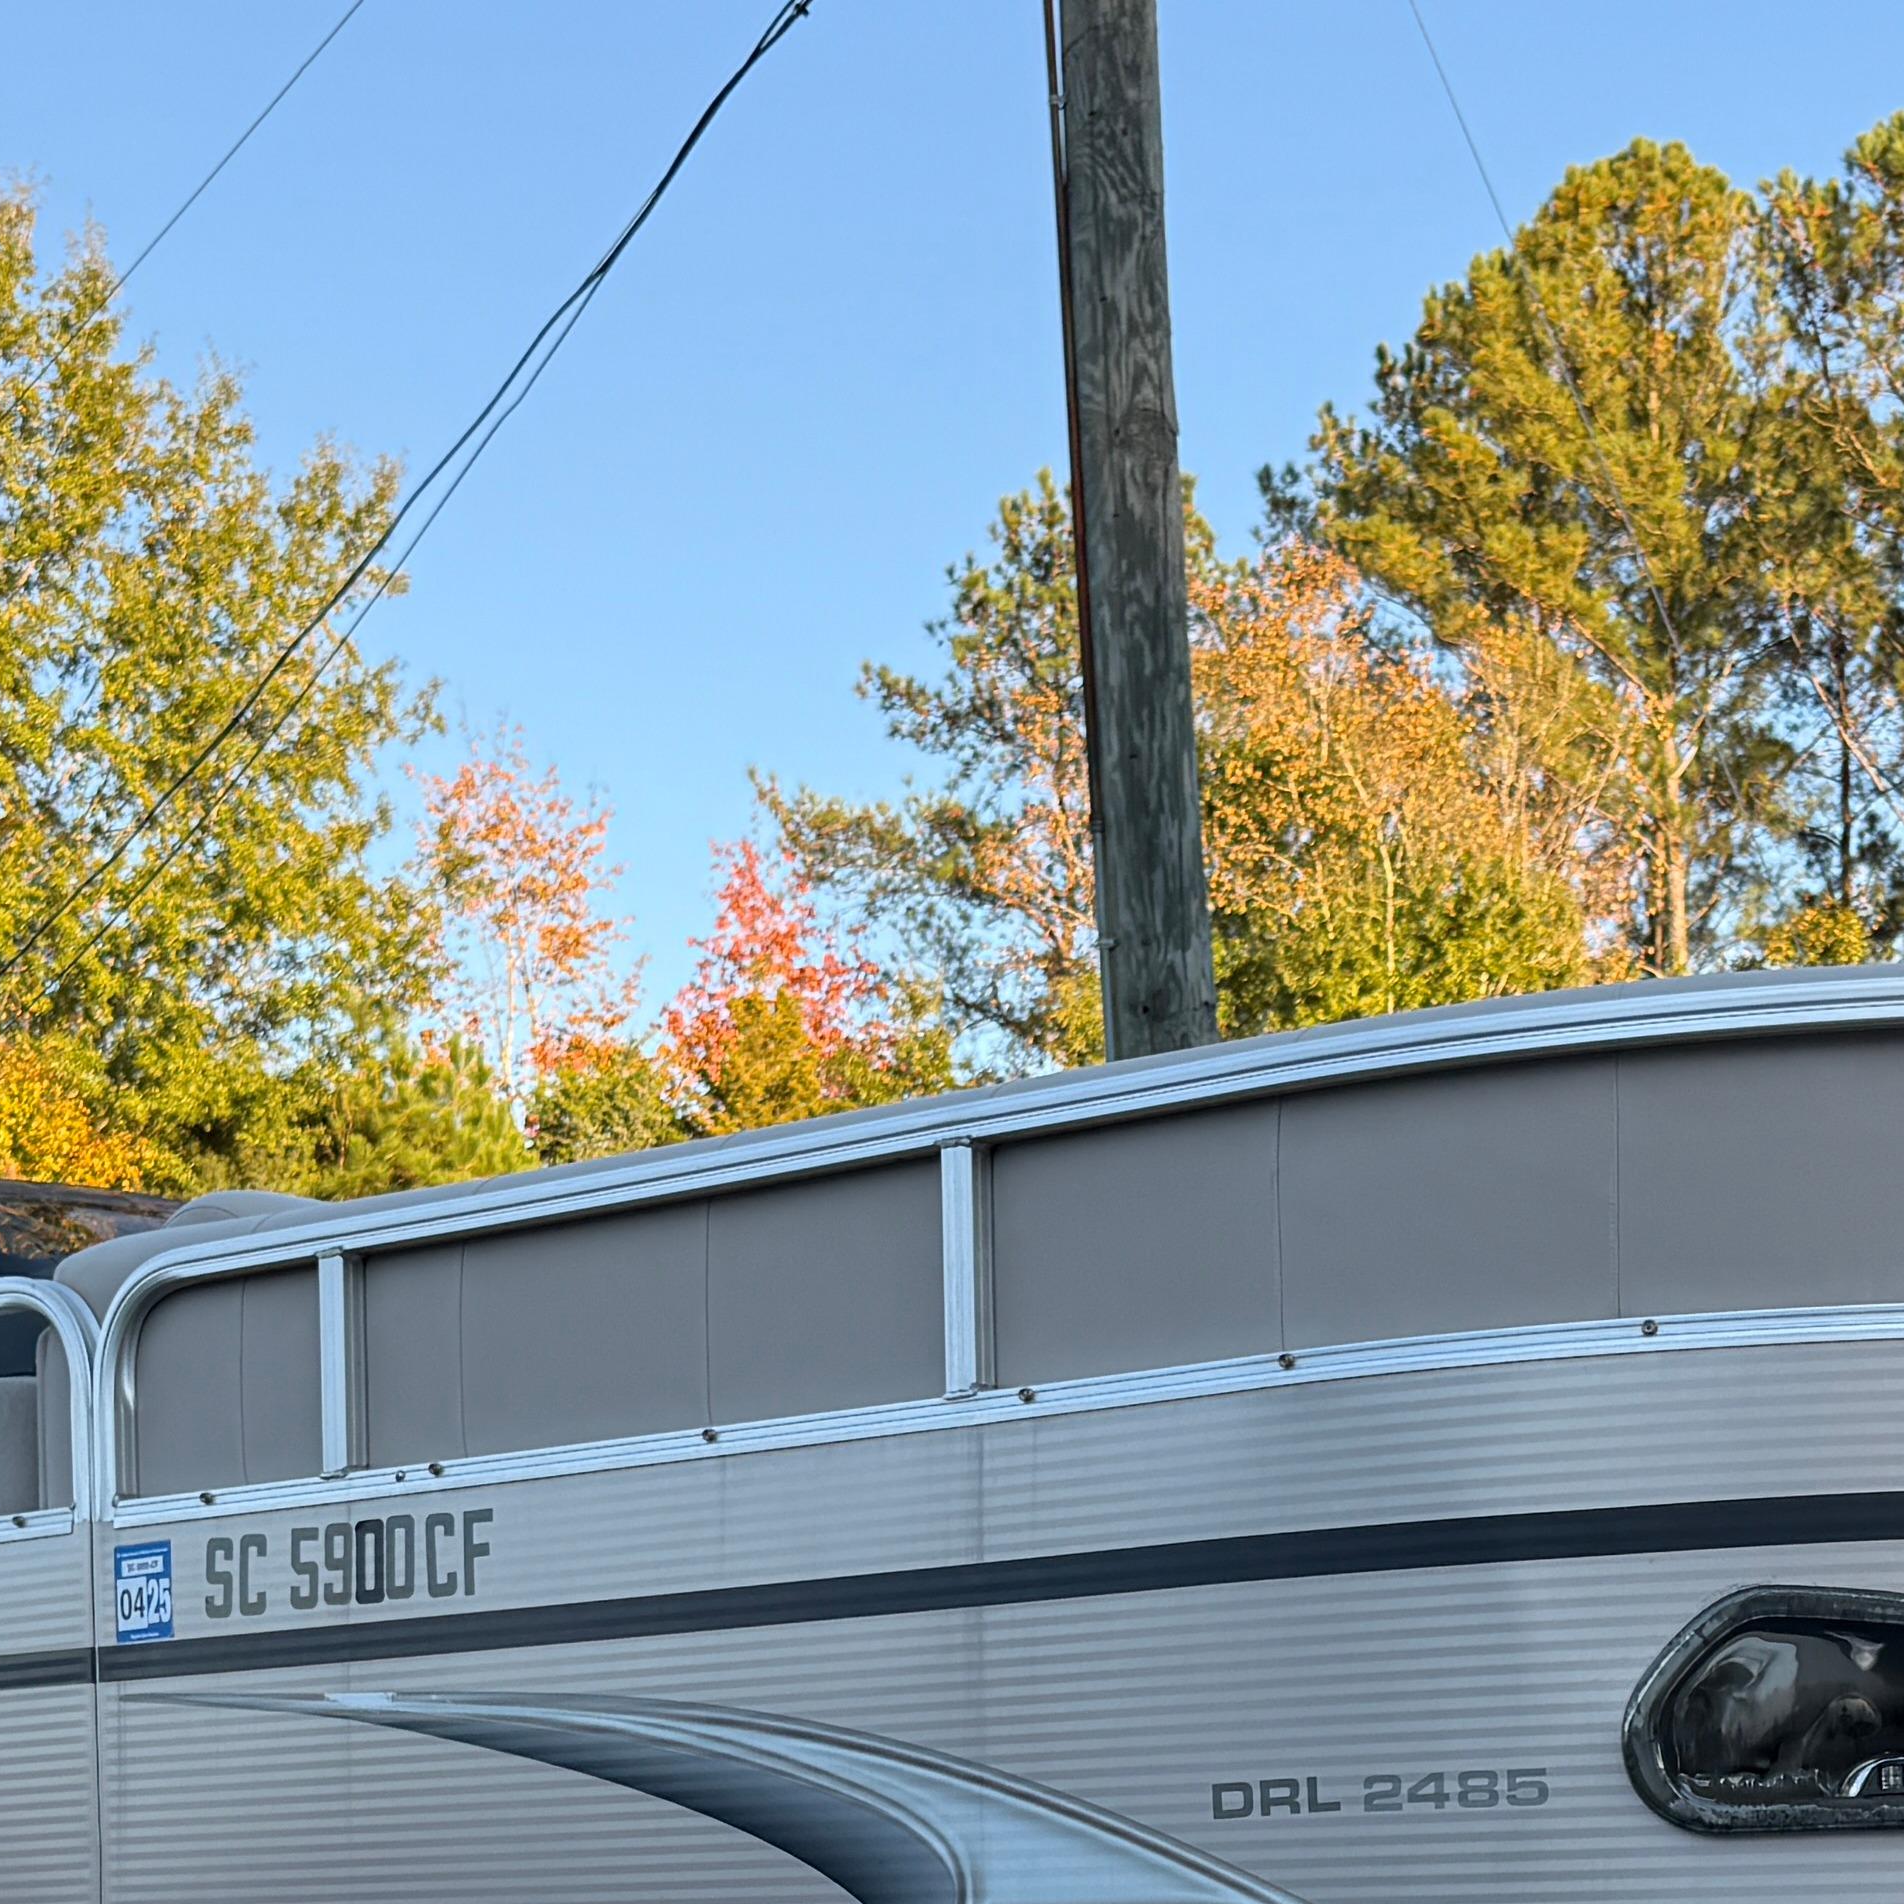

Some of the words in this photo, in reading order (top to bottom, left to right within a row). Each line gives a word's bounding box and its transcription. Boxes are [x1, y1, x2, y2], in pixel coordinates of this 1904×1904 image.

[205, 1533, 268, 1619] SC
[1211, 1775, 1342, 1820] DRL
[1363, 1767, 1550, 1813] 2485
